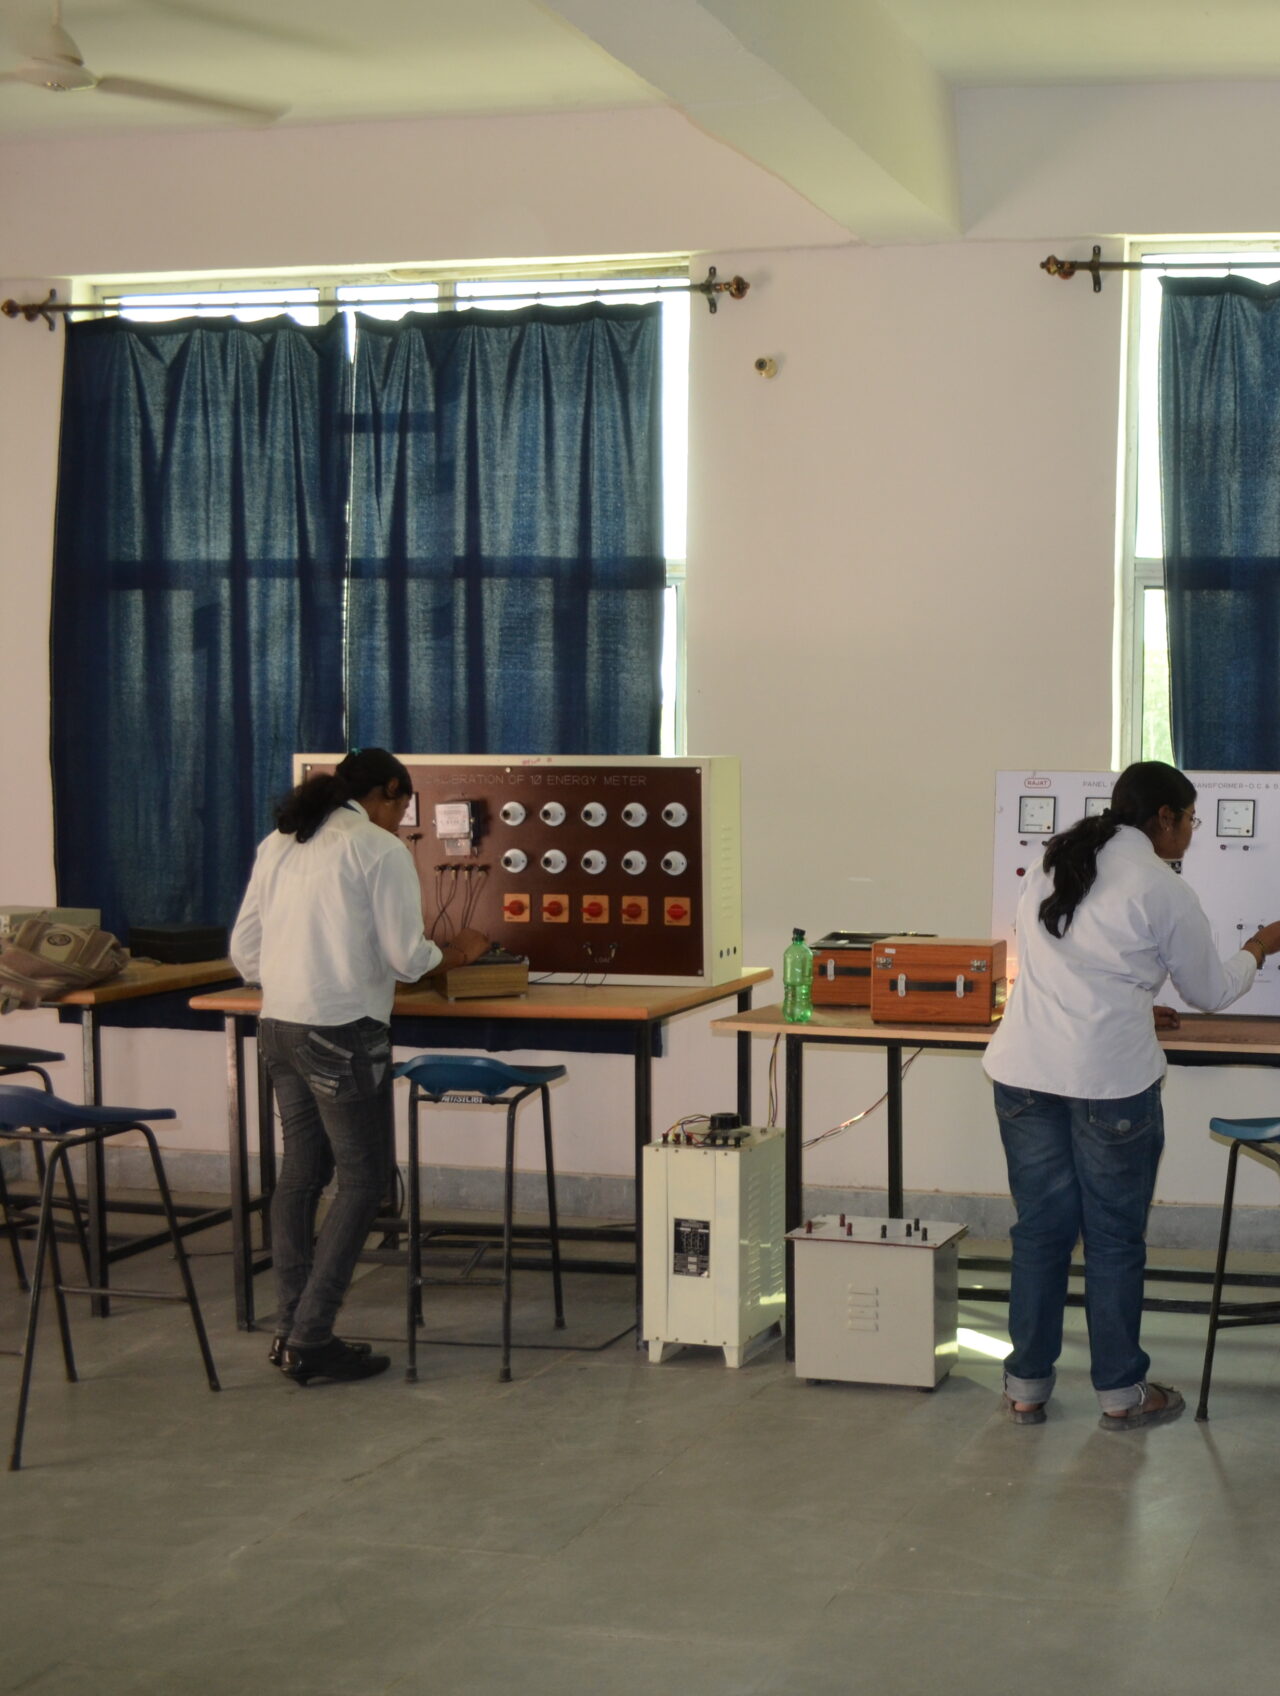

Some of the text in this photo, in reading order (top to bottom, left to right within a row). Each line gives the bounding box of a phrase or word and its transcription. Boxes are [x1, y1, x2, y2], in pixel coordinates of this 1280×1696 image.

[508, 774, 525, 785] OF
[546, 775, 598, 786] ENERGY
[603, 775, 648, 786] METER
[1082, 780, 1108, 788] PANEL
